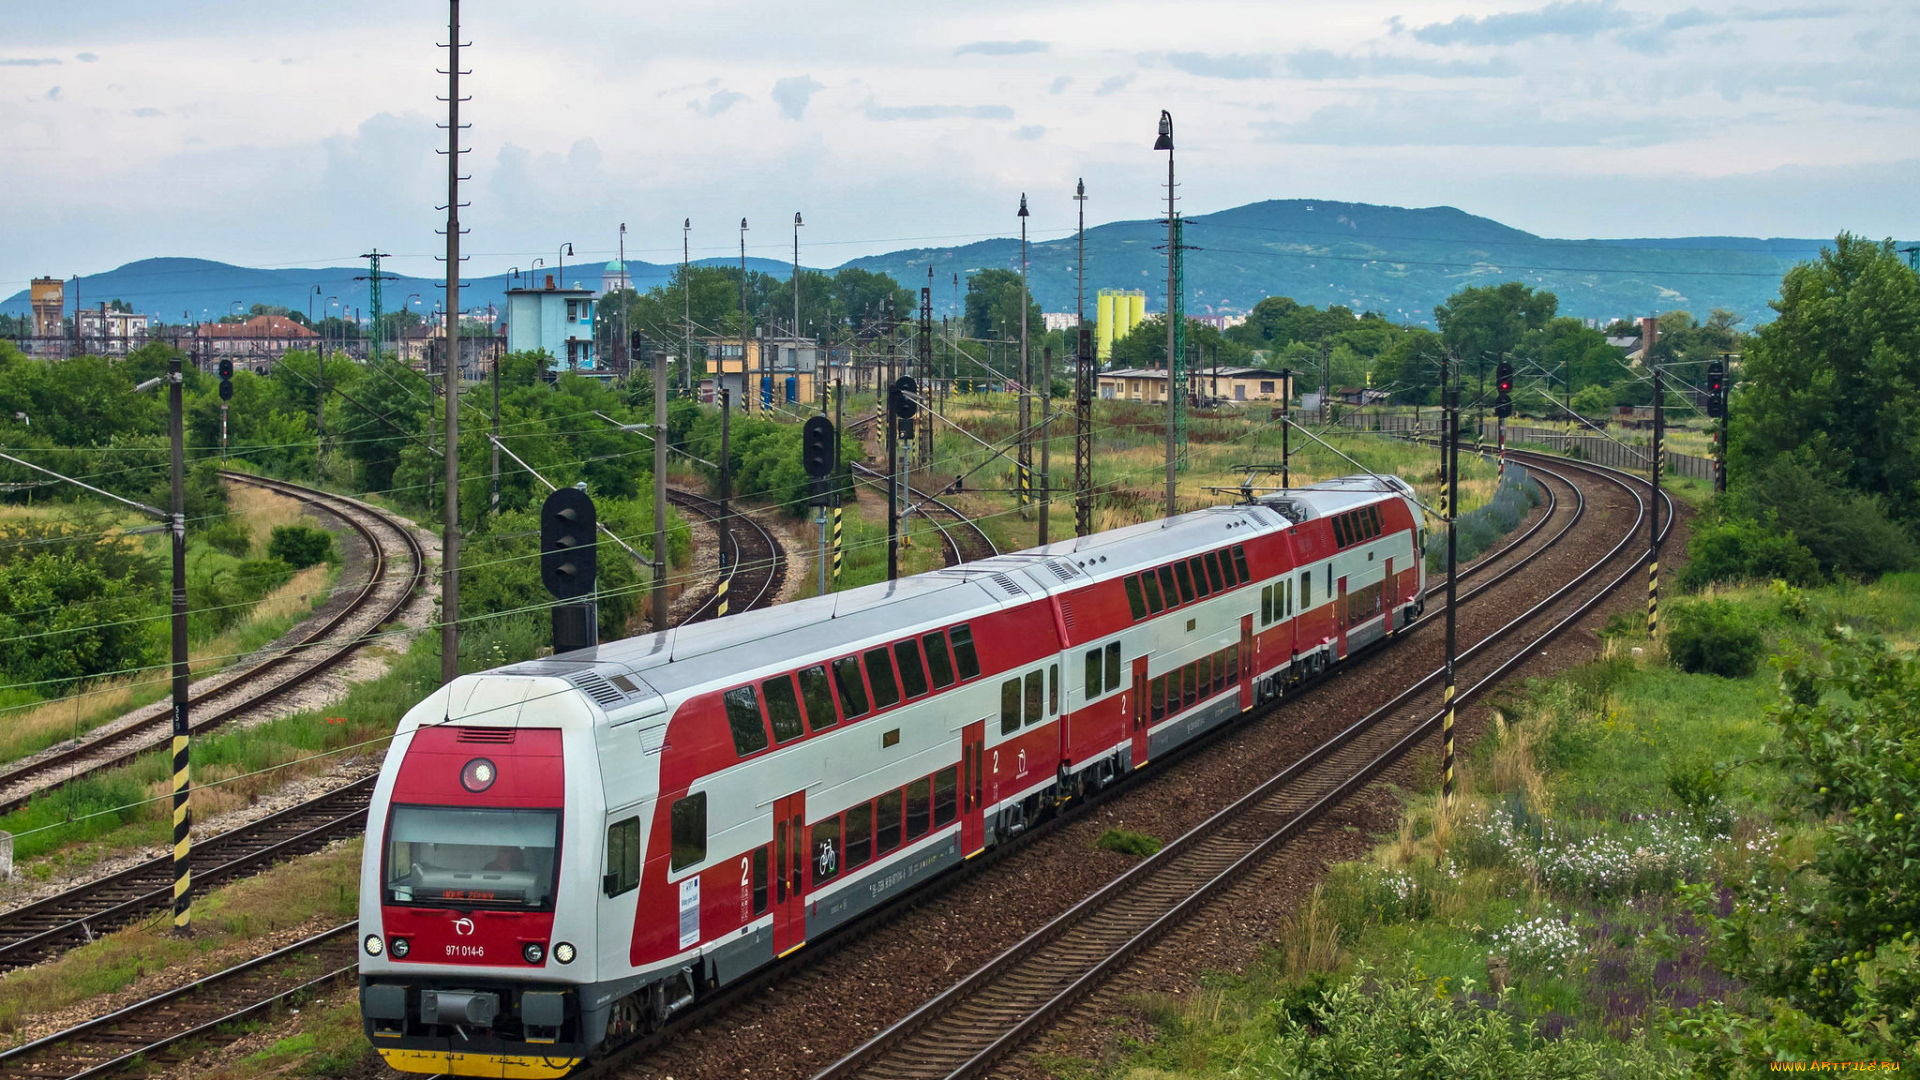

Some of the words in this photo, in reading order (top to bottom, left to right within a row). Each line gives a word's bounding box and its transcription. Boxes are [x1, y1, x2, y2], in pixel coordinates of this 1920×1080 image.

[1121, 694, 1127, 715] 2
[993, 750, 999, 774] 2
[741, 856, 749, 887] 2
[445, 944, 460, 956] 971
[461, 945, 485, 957] 014-6
